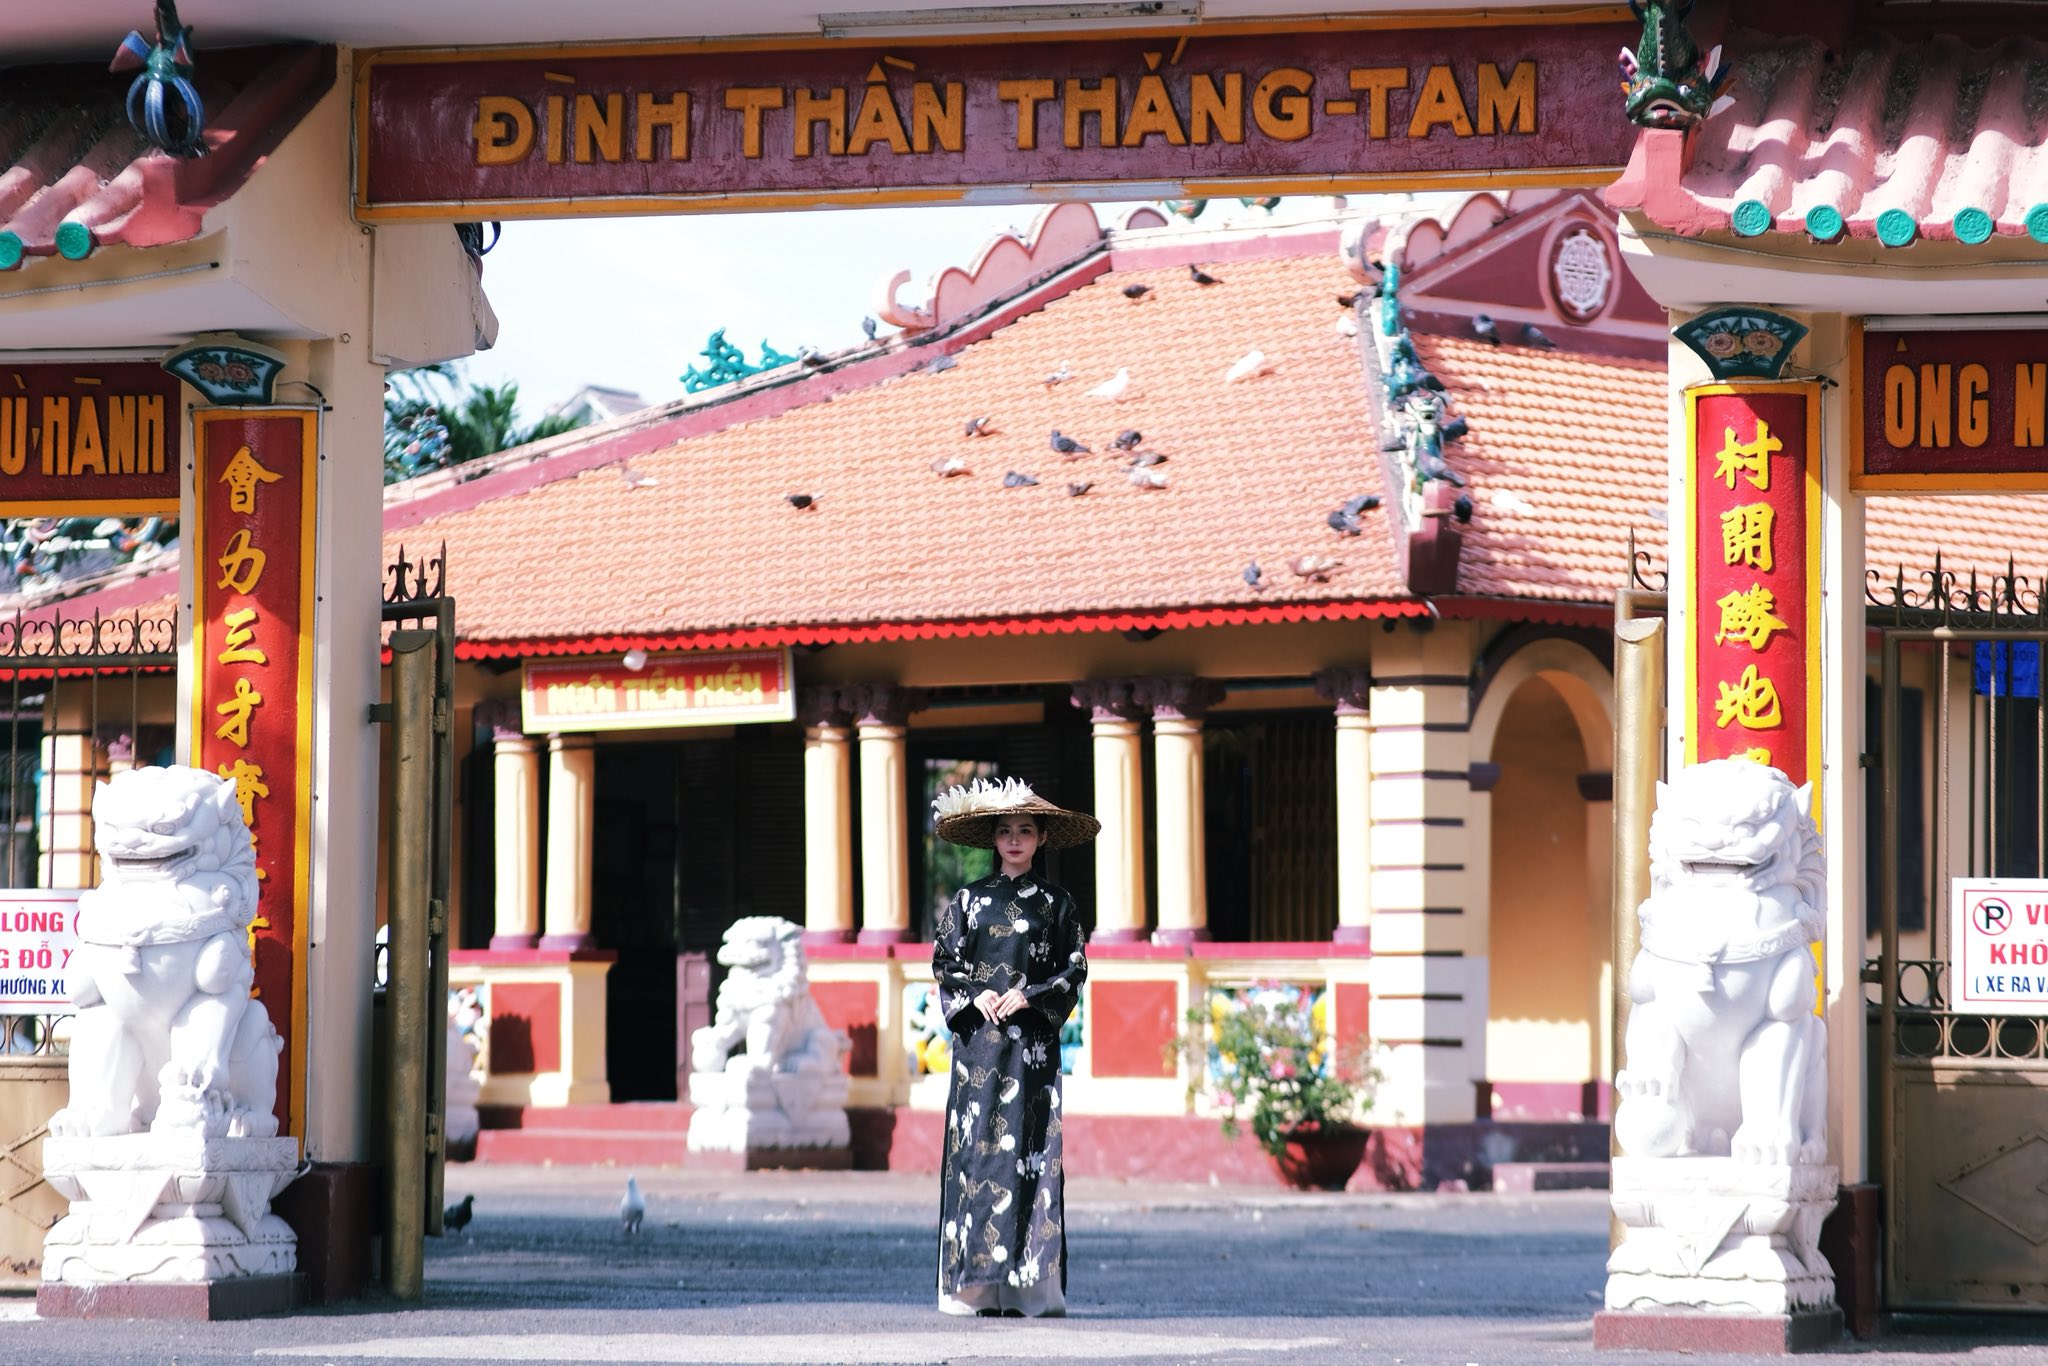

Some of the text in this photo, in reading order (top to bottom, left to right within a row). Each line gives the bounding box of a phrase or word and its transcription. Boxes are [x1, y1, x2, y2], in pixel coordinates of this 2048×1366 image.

[472, 71, 694, 166] ĐÌNH
[725, 55, 967, 160] THẦN
[1884, 337, 1990, 449] ÔNG
[1, 906, 64, 933] LÒNG
[18, 940, 53, 970] ĐỖ
[2011, 975, 2031, 993] RA
